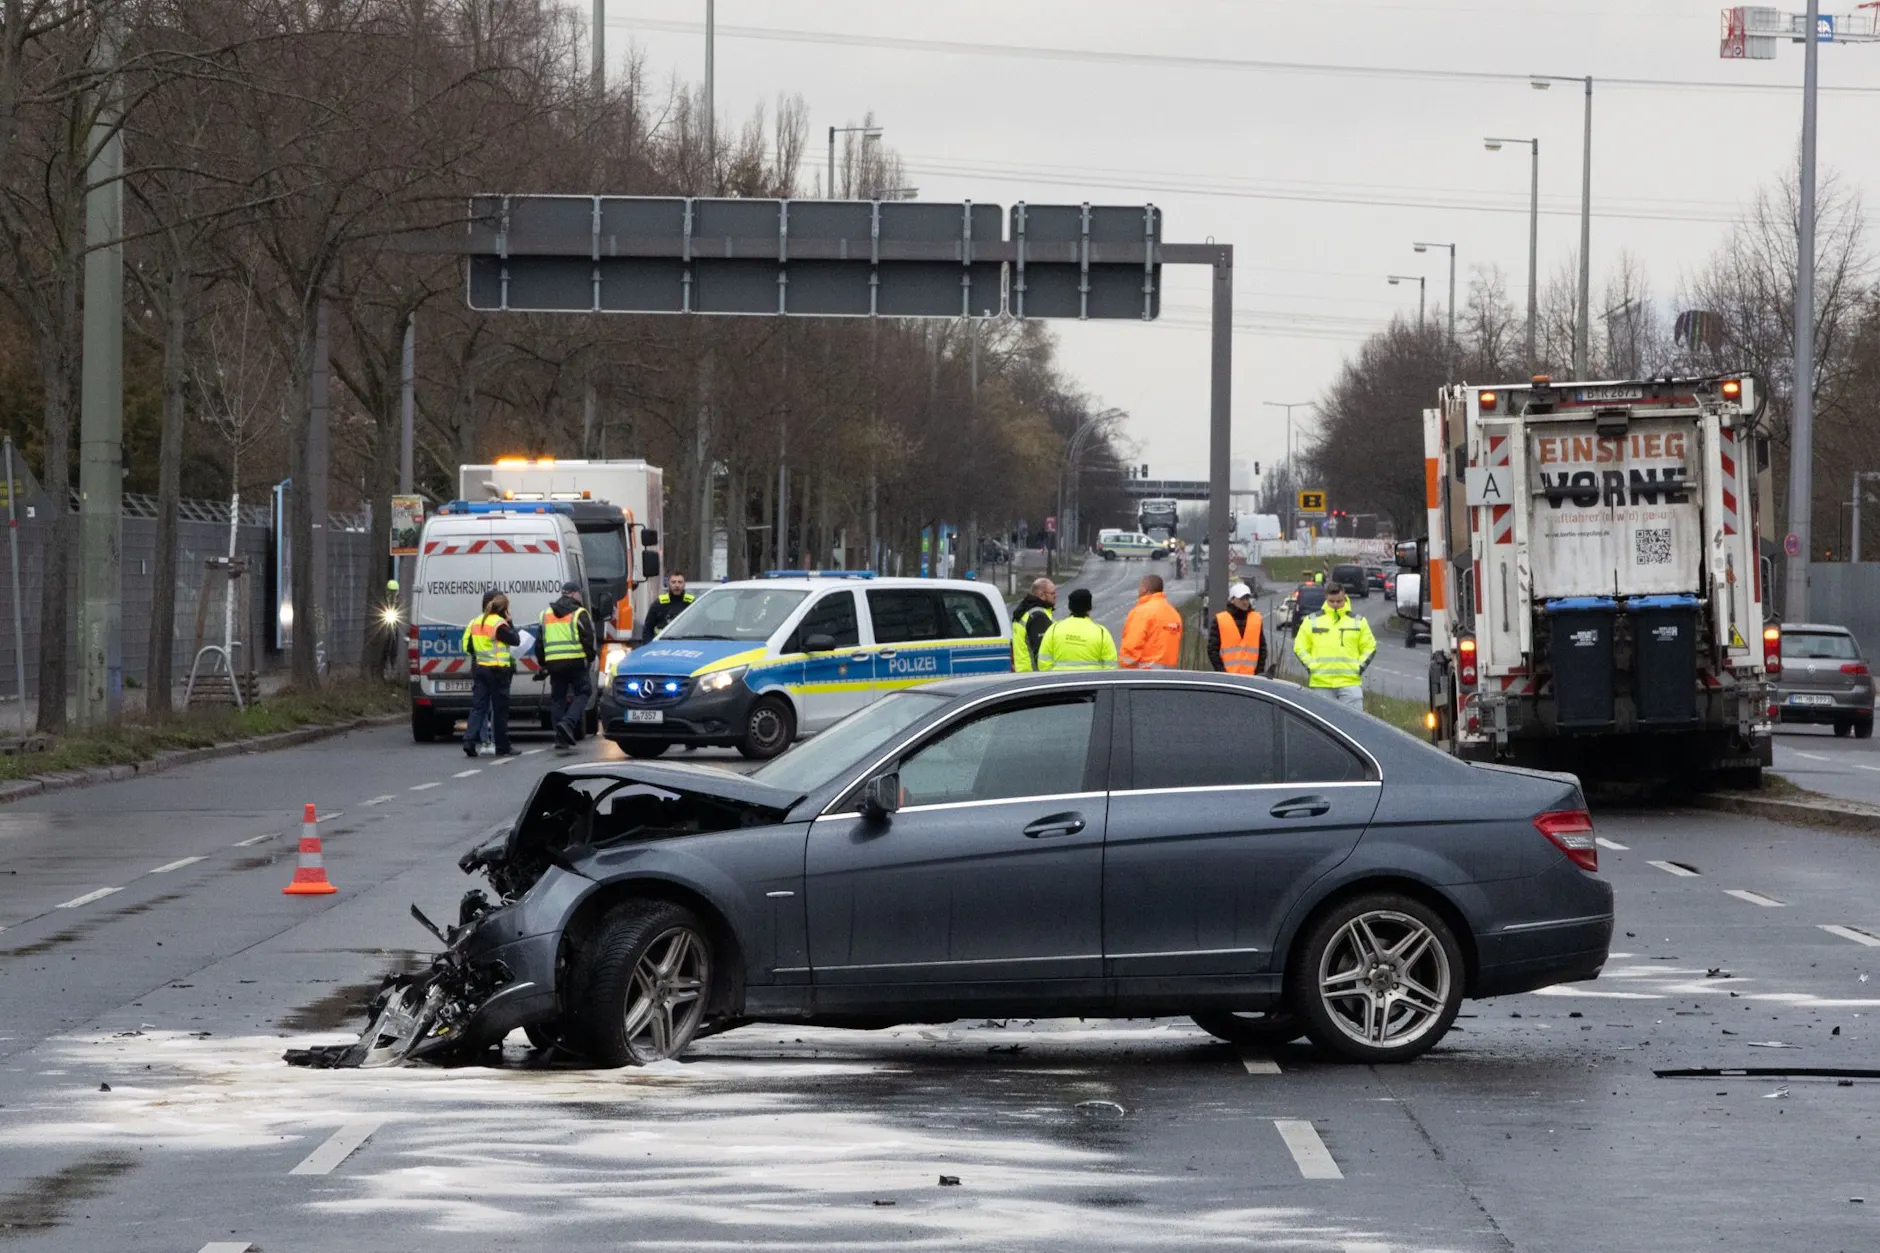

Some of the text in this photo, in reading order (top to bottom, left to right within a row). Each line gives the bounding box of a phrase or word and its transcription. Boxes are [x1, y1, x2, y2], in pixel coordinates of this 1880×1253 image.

[1538, 432, 1685, 465] EINSTIEG
[1482, 472, 1501, 499] A
[1539, 467, 1690, 509] VORNE
[427, 580, 561, 595] VERKEHRSUNFALLKOMMANDO
[641, 649, 704, 658] POLIZEI
[889, 656, 937, 674] POLIZEI
